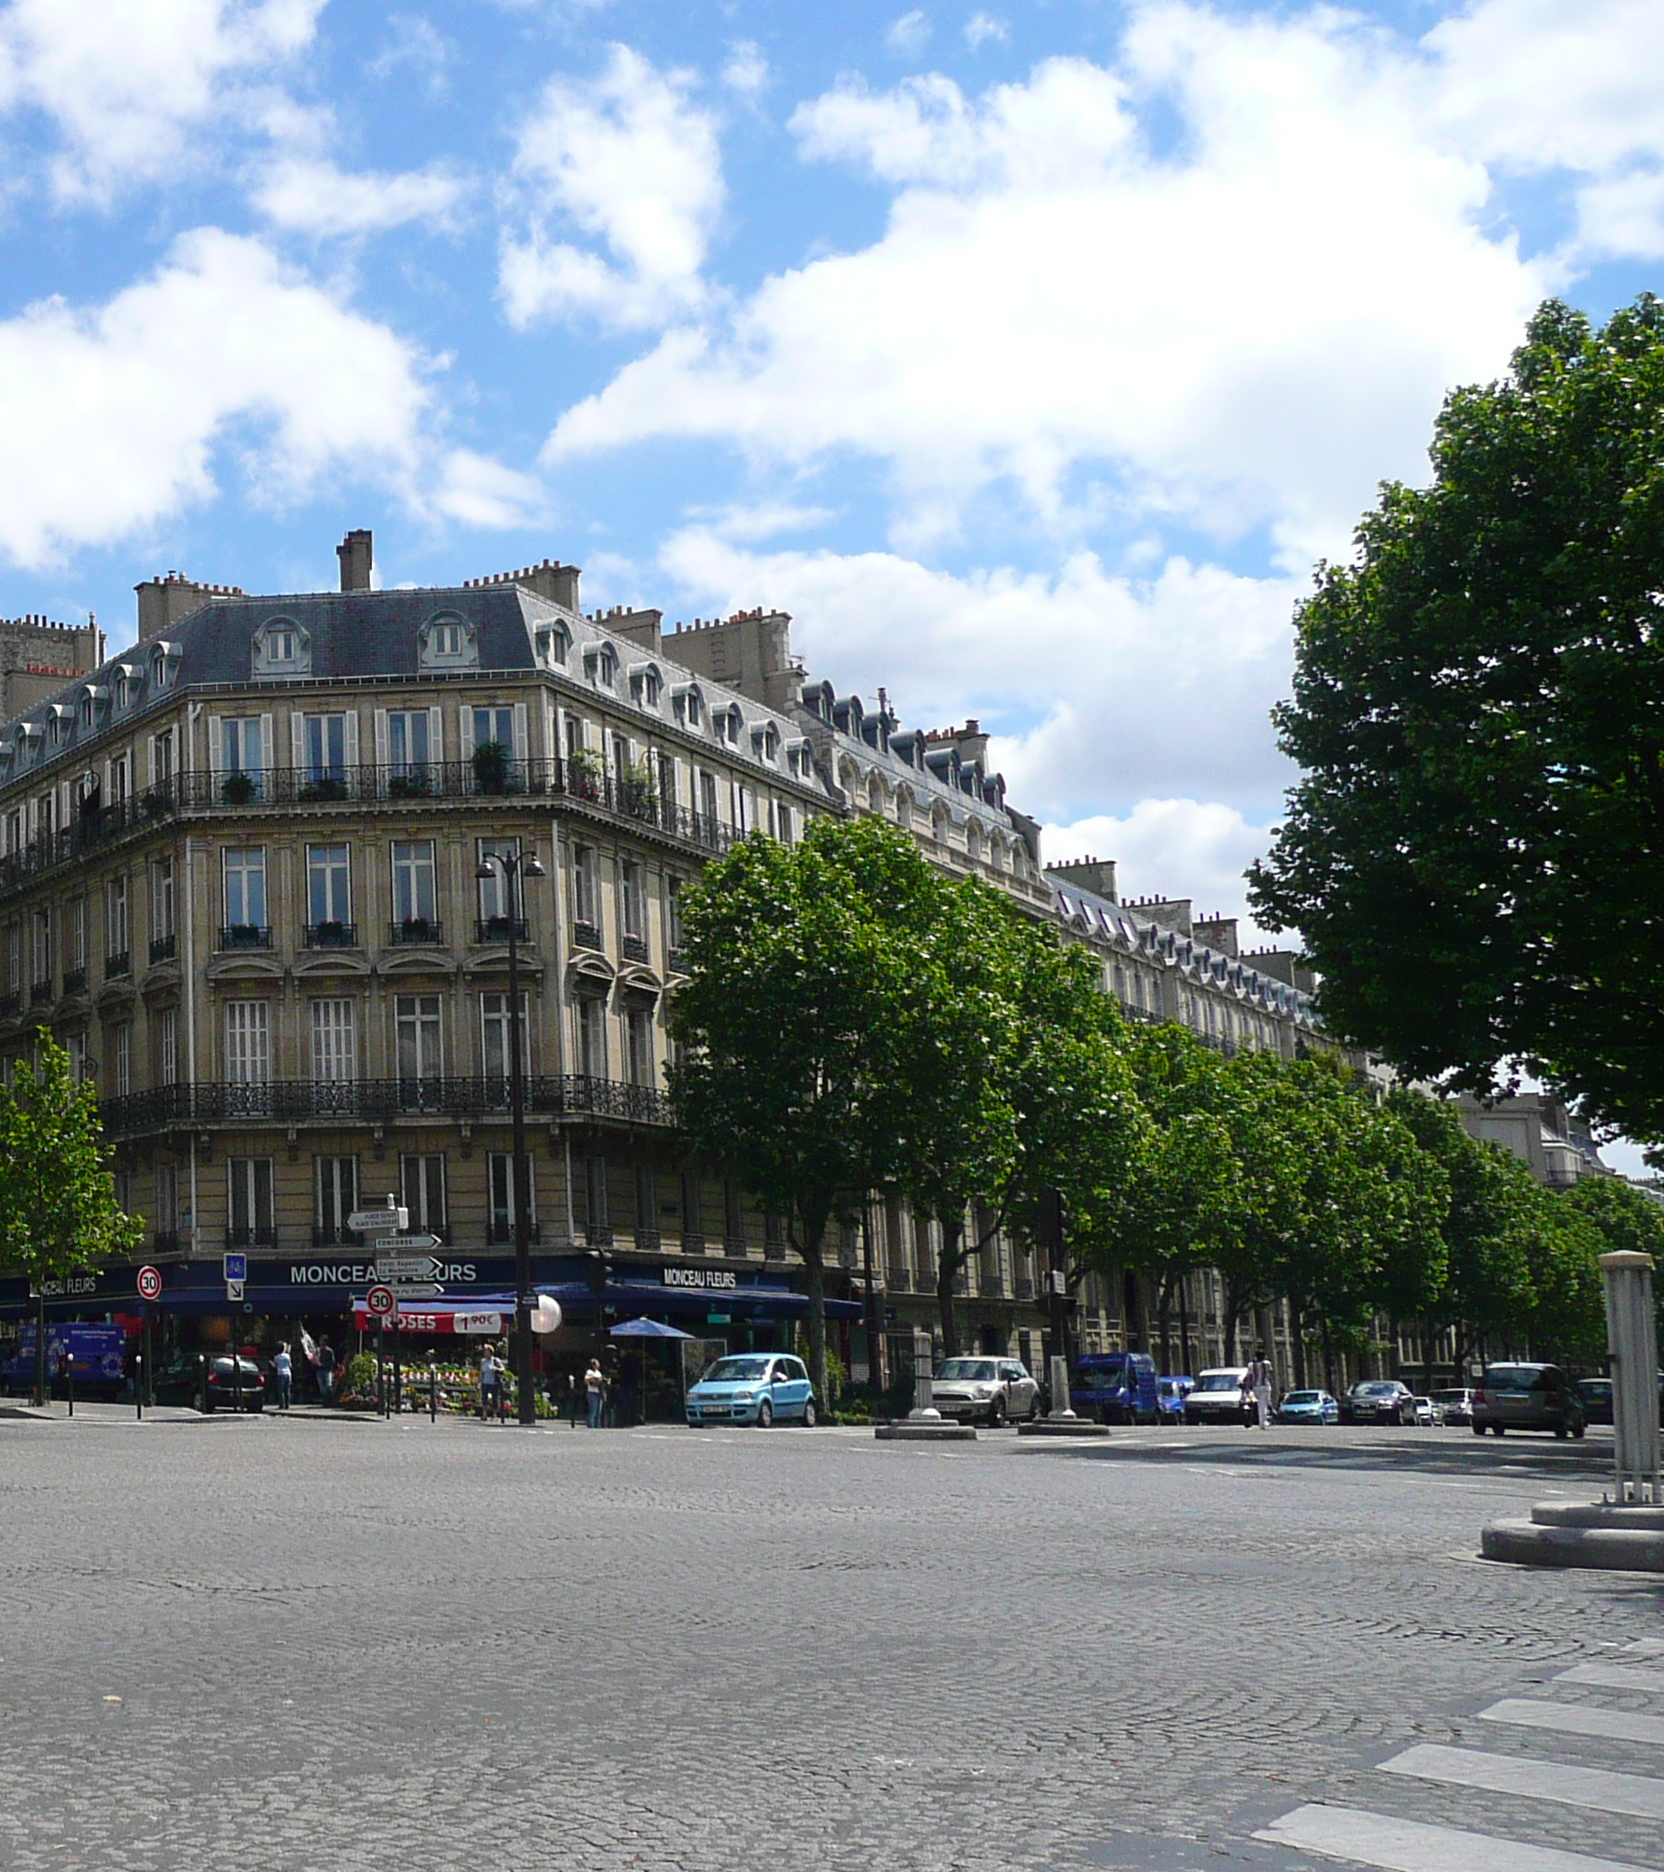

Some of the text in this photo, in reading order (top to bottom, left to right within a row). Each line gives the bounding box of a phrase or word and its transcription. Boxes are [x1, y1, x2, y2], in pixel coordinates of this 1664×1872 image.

[66, 1276, 96, 1294] FLEURS
[142, 1276, 157, 1290] 30
[663, 1268, 737, 1289] MONCEAU FLEURS
[372, 1295, 389, 1308] 30
[381, 1315, 437, 1330] ROSES
